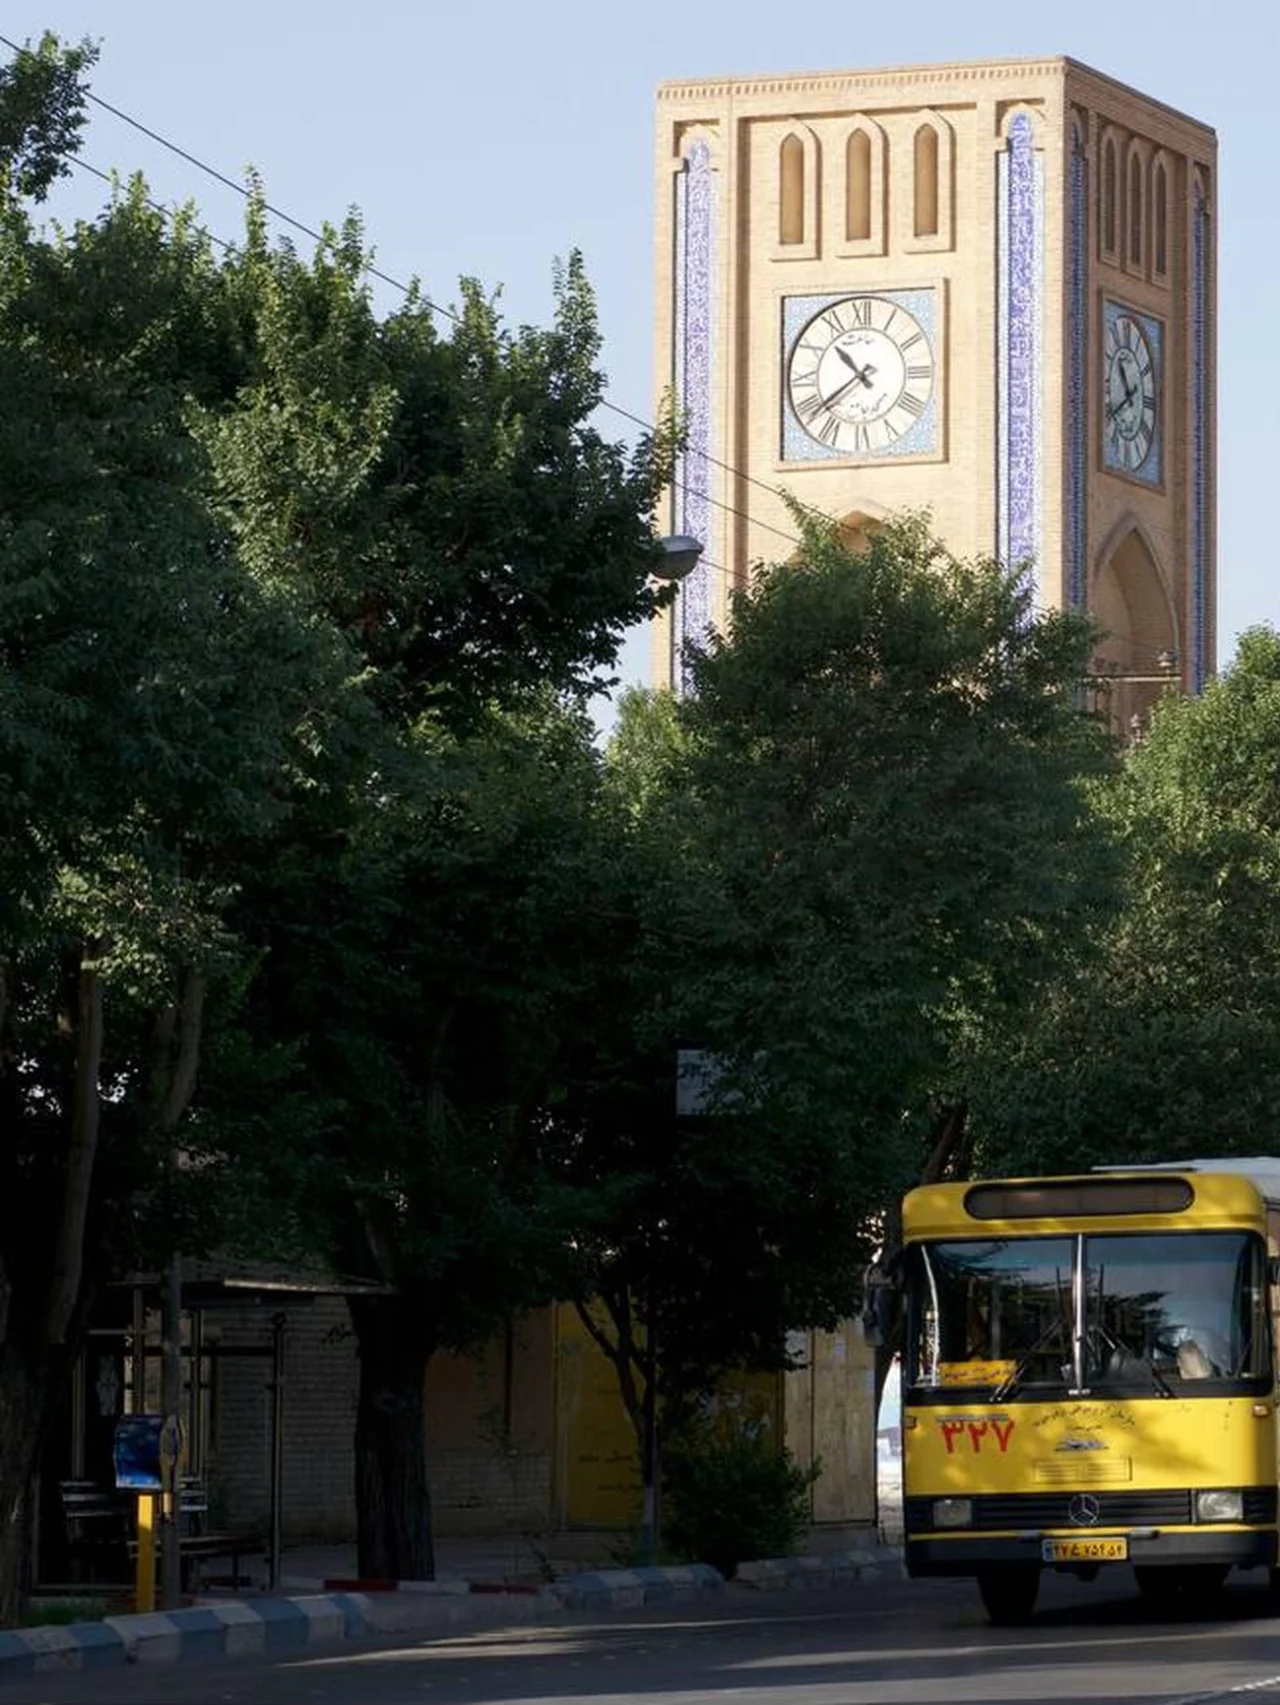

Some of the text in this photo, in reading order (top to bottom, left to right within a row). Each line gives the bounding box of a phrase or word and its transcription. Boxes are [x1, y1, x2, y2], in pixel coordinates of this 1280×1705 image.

[852, 301, 872, 326] XII
[883, 308, 897, 331] I
[900, 332, 923, 351] II
[907, 365, 931, 379] III
[942, 1418, 1016, 1454] ۳۲۷
